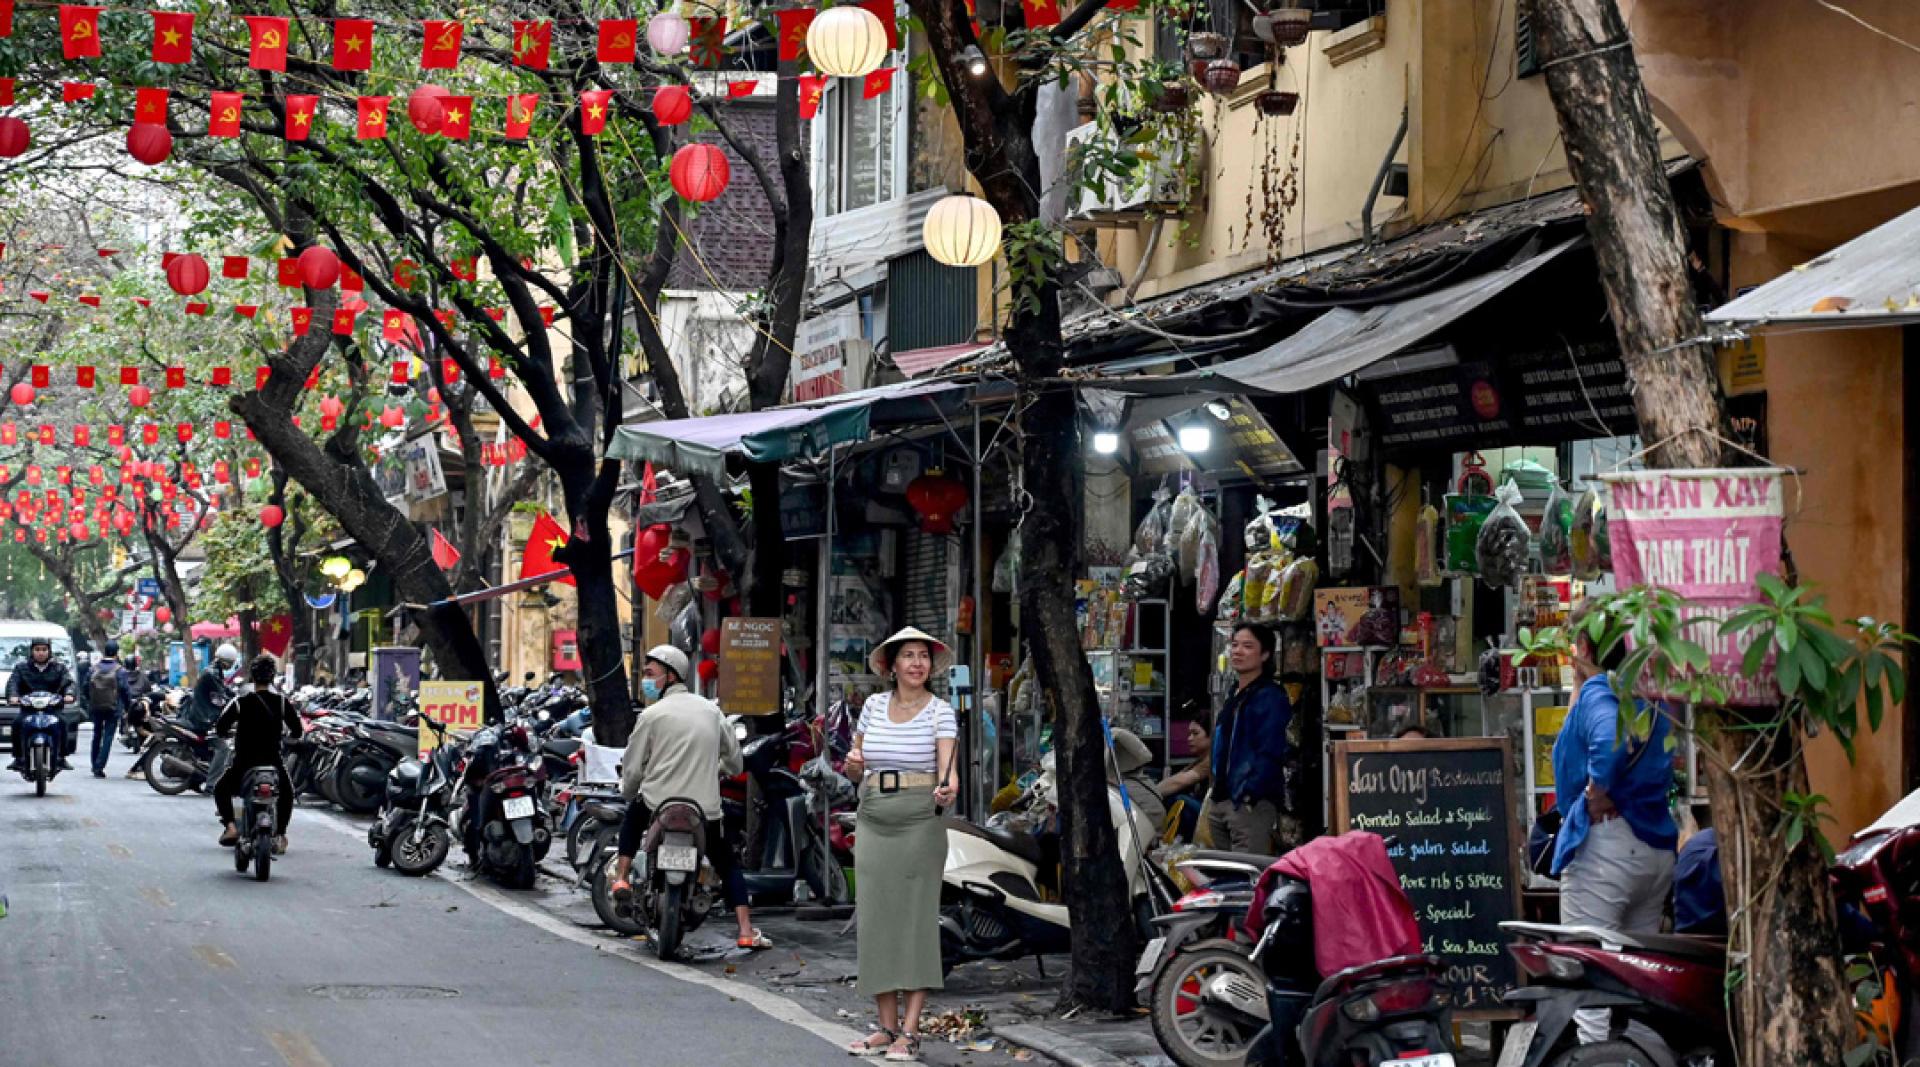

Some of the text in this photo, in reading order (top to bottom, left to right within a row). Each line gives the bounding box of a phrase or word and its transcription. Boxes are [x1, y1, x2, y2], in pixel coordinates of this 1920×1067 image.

[1713, 475, 1773, 508] XAY
[1691, 520, 1751, 586] THẤT
[1389, 764, 1428, 805] Ong
[1405, 806, 1443, 826] Salad
[1409, 838, 1446, 862] palm
[1450, 838, 1491, 857] Salad
[1430, 871, 1451, 890] rib
[1455, 874, 1465, 890] 5
[1425, 900, 1476, 924] Special
[1441, 938, 1464, 954] Sea
[1465, 938, 1500, 955] Bass
